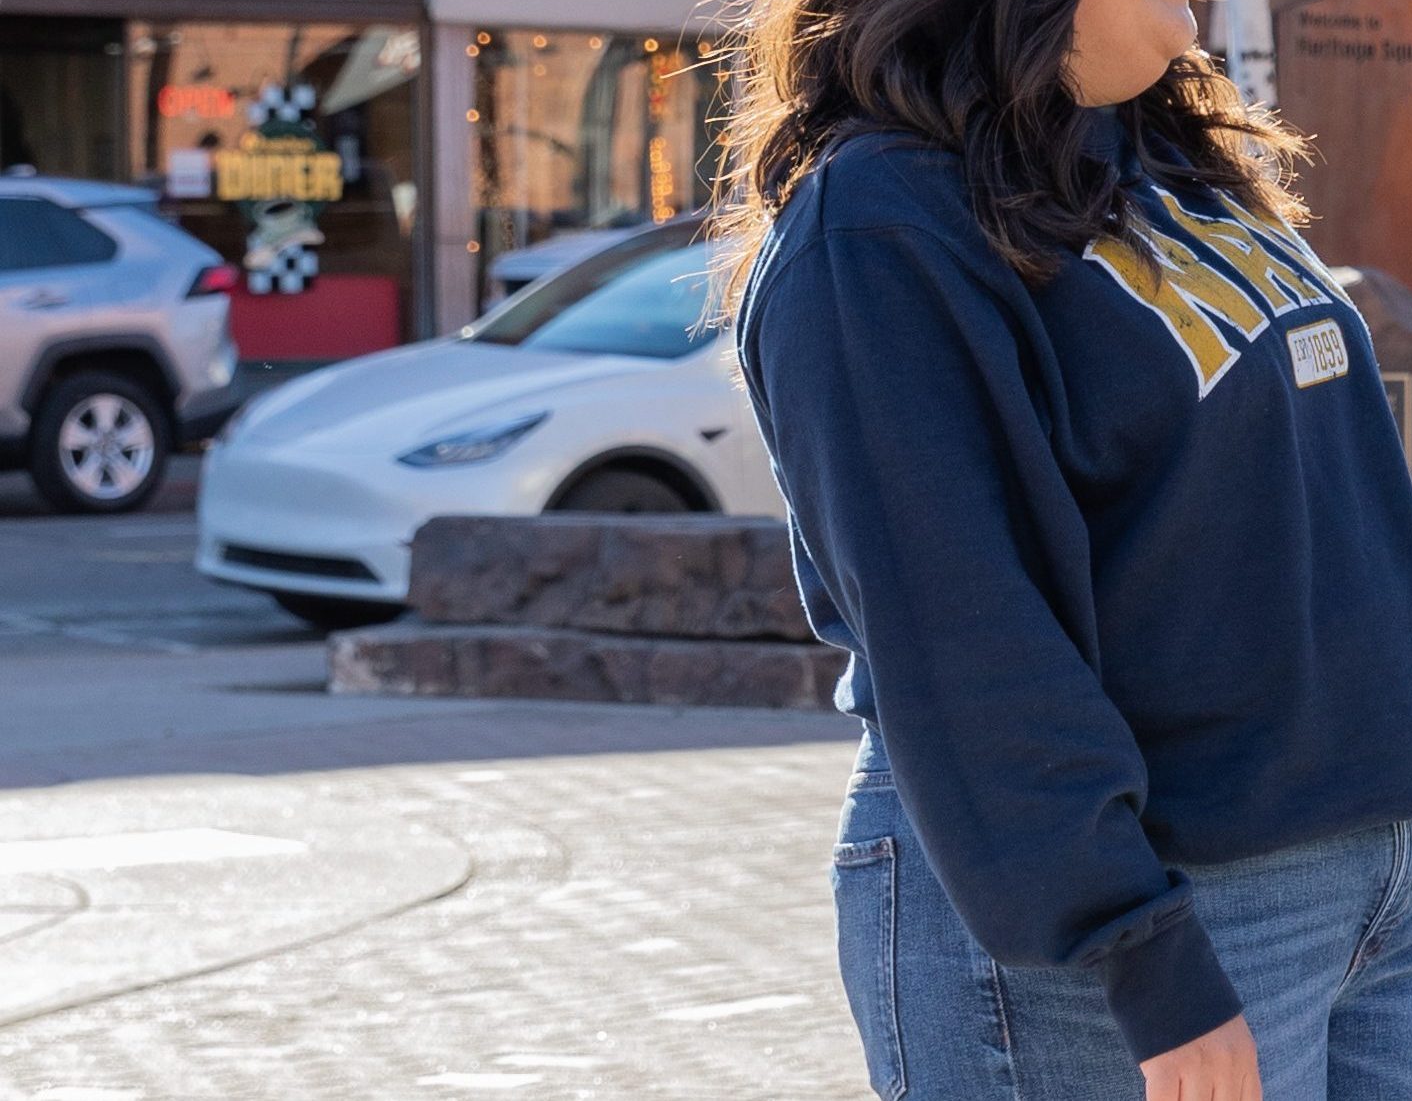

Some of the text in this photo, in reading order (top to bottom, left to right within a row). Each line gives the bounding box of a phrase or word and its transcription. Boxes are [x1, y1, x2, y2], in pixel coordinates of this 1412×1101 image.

[1300, 12, 1361, 30] Welcome
[215, 150, 344, 202] DINER
[1308, 329, 1344, 373] 1899
